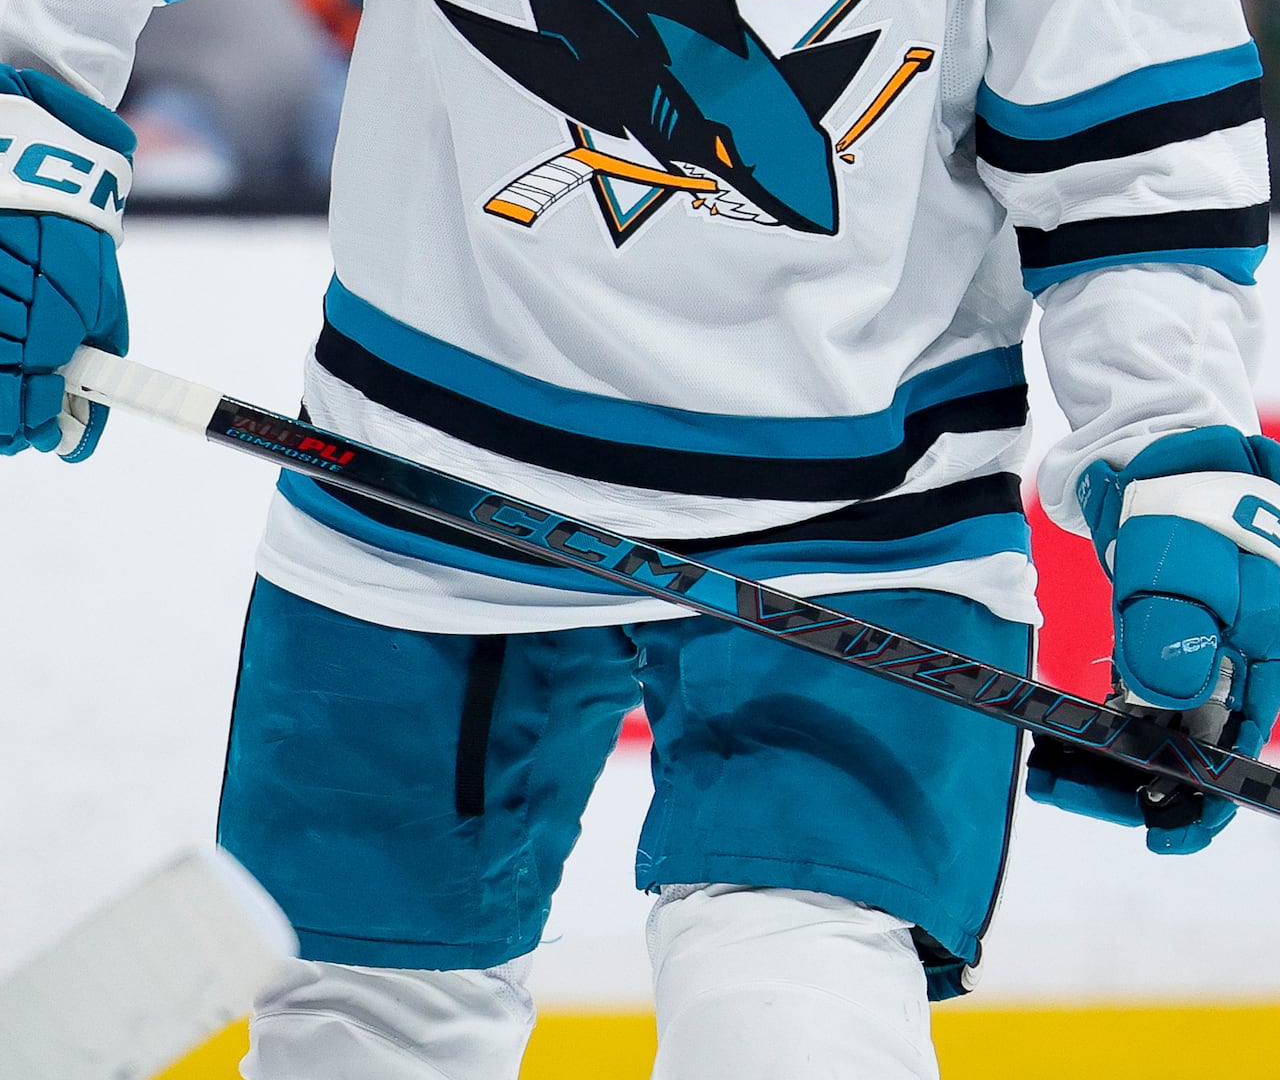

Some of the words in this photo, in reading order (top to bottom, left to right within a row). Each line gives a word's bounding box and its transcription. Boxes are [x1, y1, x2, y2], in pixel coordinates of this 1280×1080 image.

[225, 428, 344, 473] COMPOSITE
[469, 493, 709, 596] CCM
[1160, 634, 1218, 661] CCM
